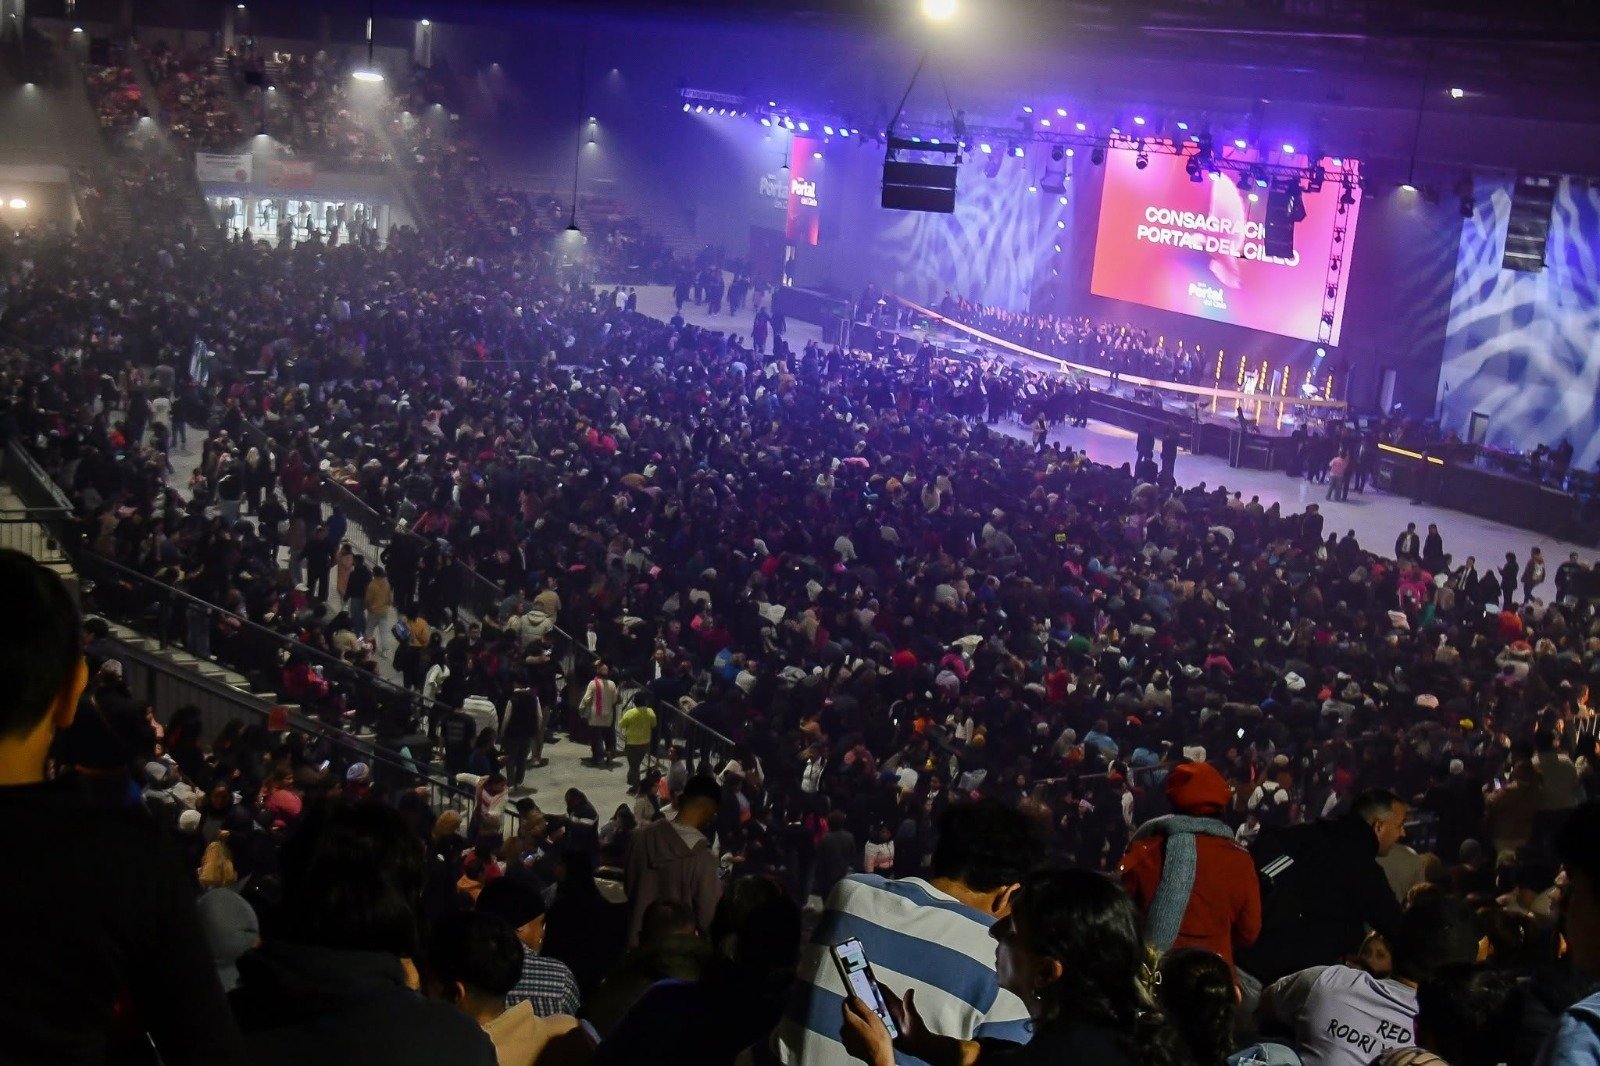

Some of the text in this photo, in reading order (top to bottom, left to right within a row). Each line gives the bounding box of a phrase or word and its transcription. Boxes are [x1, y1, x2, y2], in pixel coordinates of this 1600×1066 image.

[791, 179, 816, 198] Portal
[1145, 206, 1266, 240] CONSAGRACI
[1205, 237, 1241, 258] DEL
[1327, 1019, 1377, 1053] RODRI
[1376, 1019, 1411, 1043] RED
